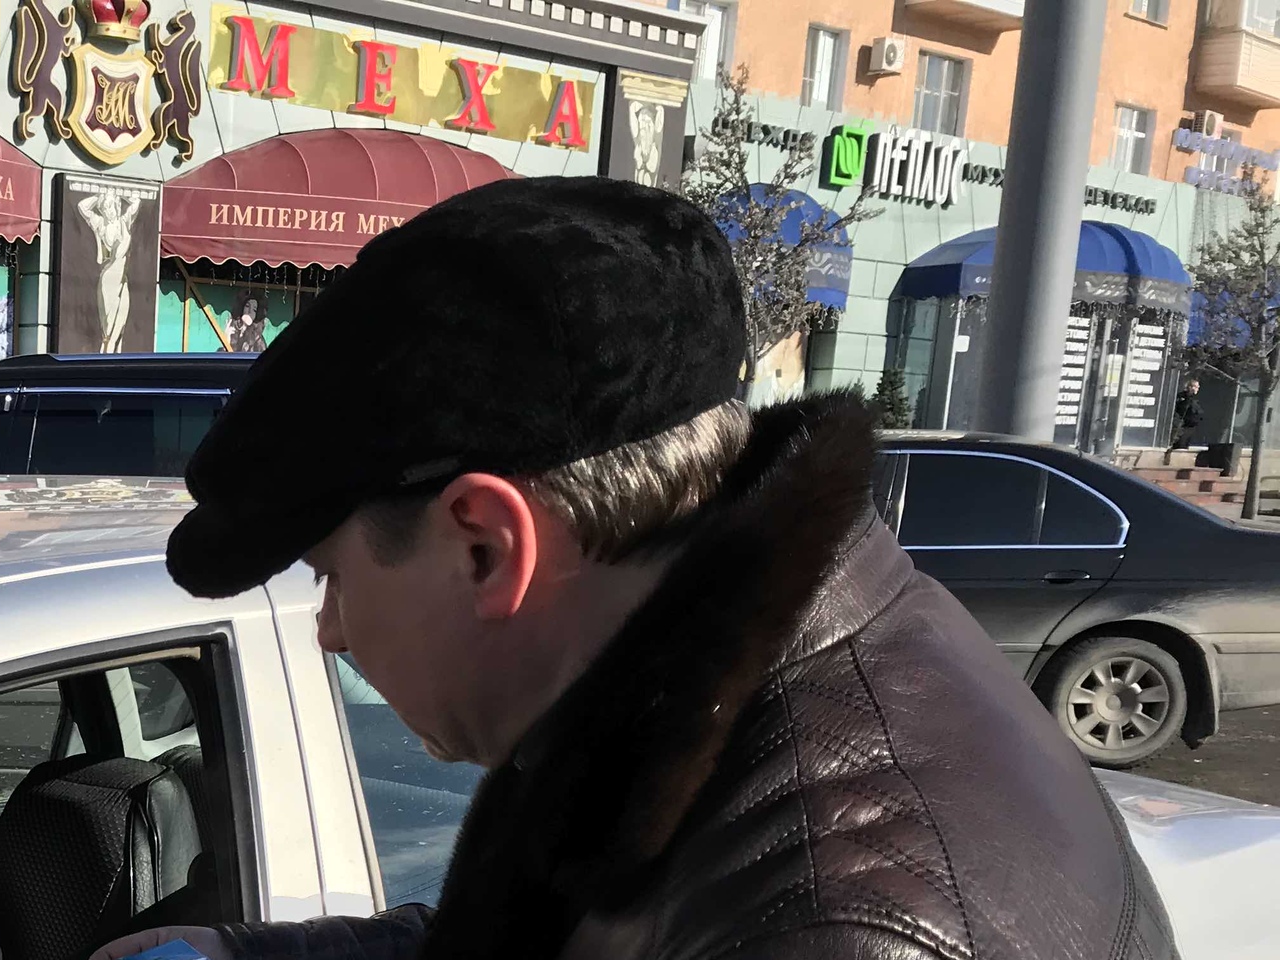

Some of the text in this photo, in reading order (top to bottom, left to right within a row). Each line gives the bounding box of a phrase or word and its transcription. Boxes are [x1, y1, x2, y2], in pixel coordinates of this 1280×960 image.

[223, 16, 586, 147] МЕХА
[1084, 185, 1157, 215] ДЕТСКАЯ
[209, 203, 346, 233] ИМПЕРИЯ
